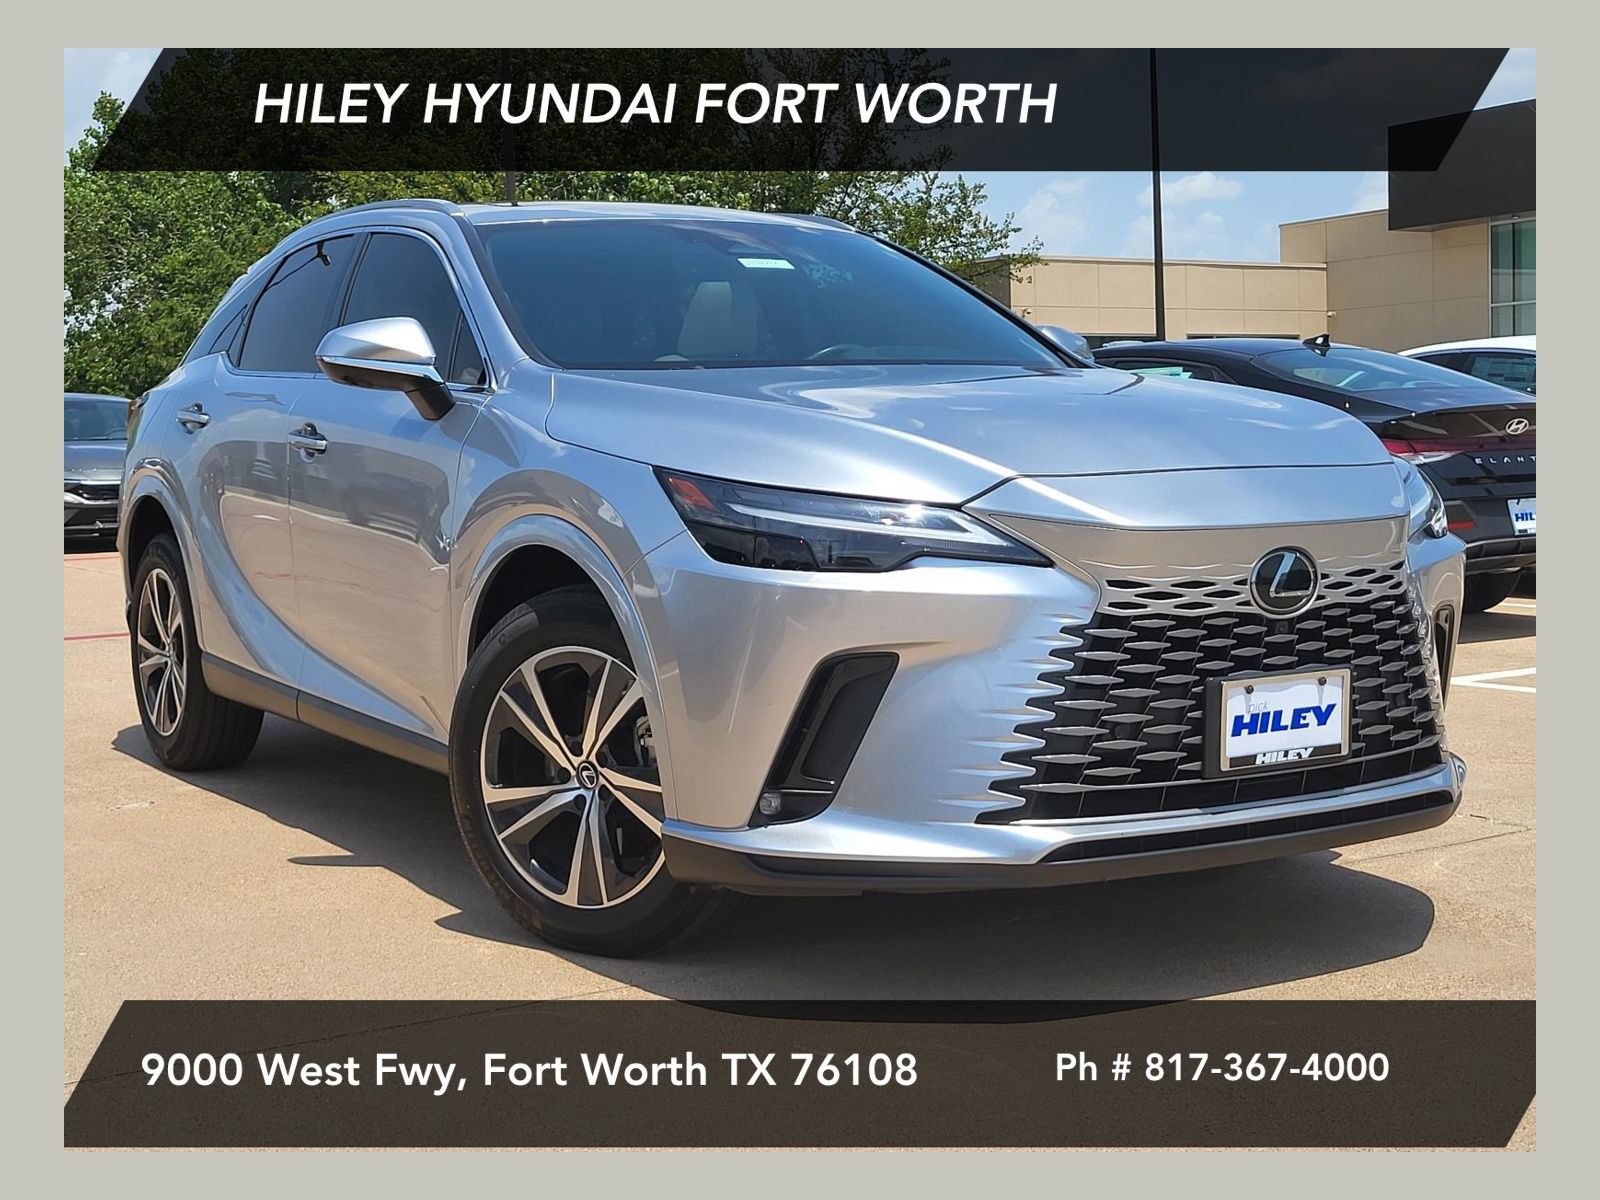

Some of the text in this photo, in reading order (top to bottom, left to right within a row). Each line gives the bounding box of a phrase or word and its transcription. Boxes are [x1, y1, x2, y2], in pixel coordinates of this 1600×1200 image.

[1515, 512, 1536, 521] HIL
[1231, 703, 1337, 737] HILEY
[1255, 747, 1314, 765] HILEY
